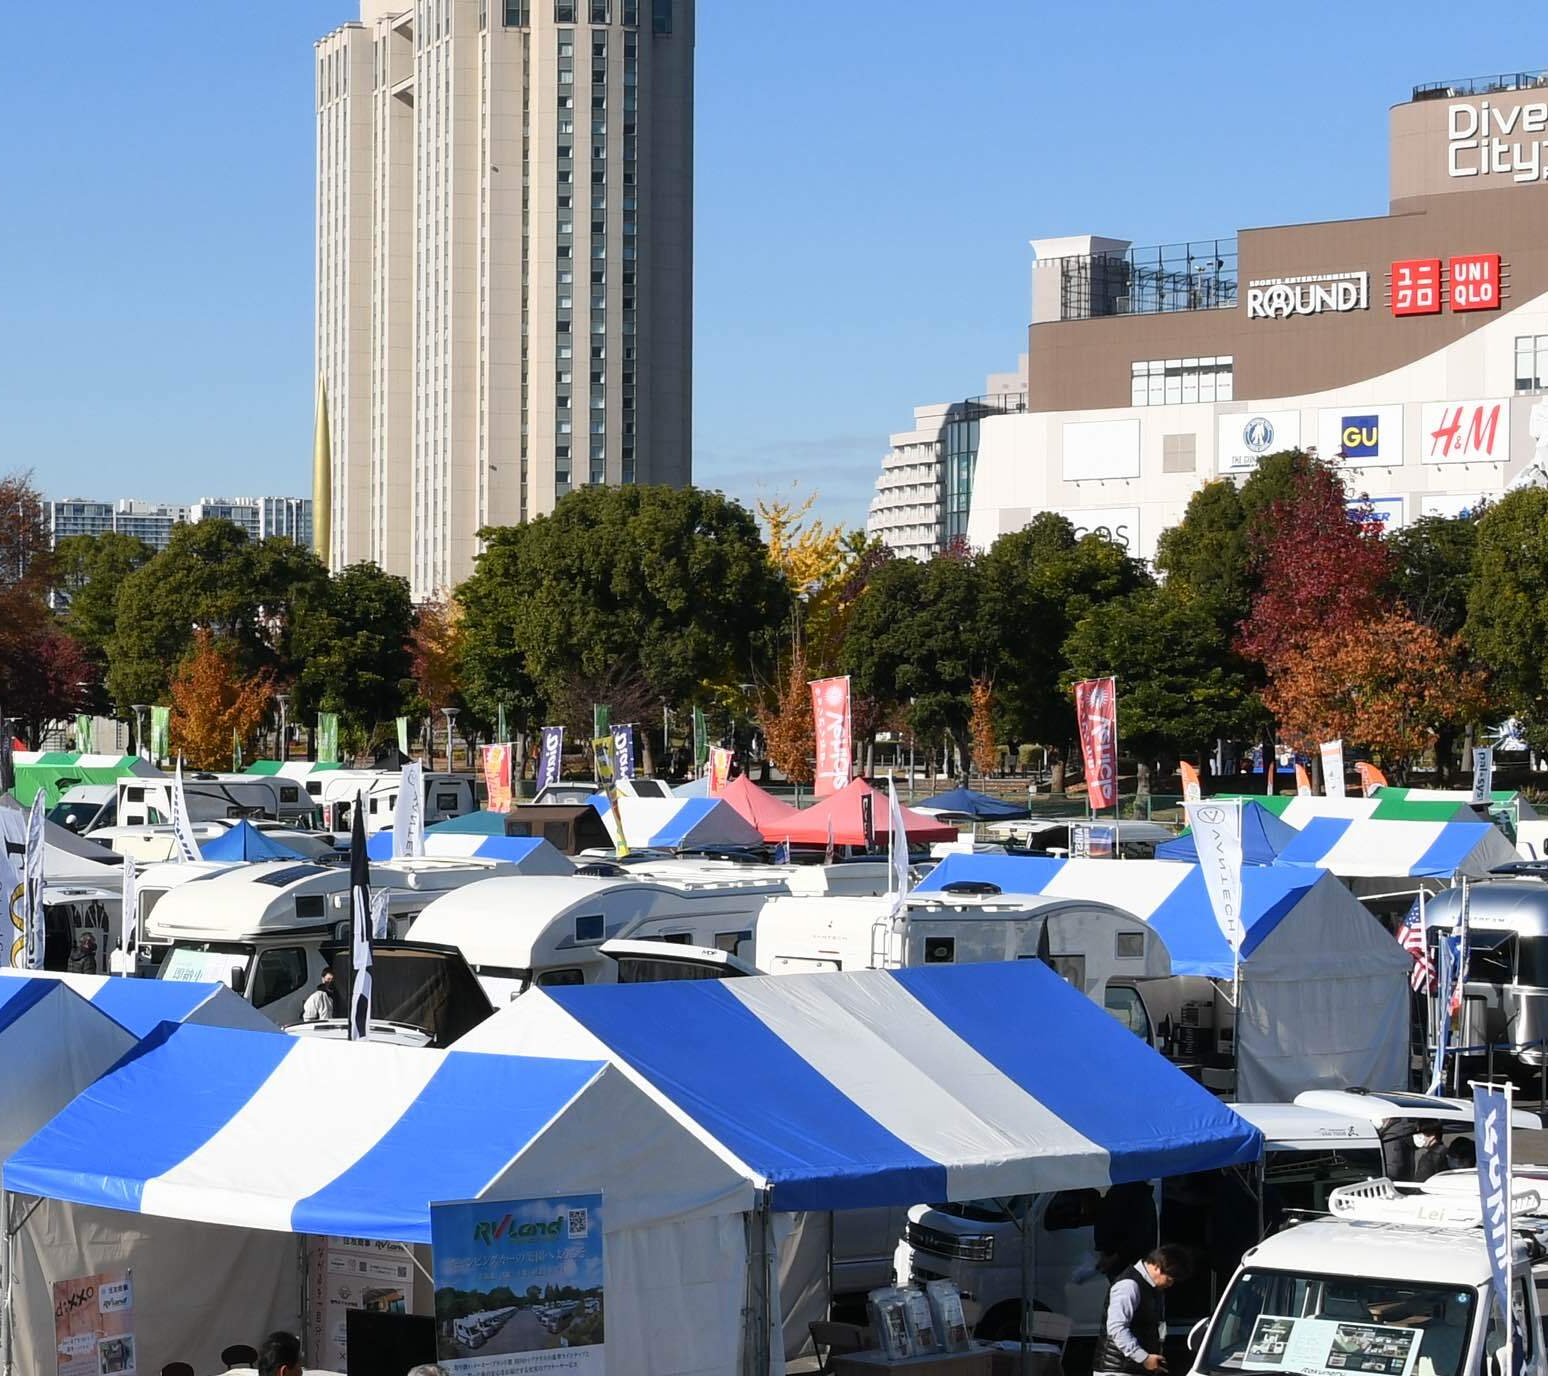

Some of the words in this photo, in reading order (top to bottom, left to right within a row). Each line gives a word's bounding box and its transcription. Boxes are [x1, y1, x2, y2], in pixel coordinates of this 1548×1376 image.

[1448, 137, 1540, 183] City
[1397, 266, 1433, 286] ユニ
[1454, 262, 1490, 281] UNI
[1397, 288, 1433, 308] クロ
[1454, 284, 1492, 306] QLO
[1343, 426, 1378, 447] GU
[1430, 404, 1501, 457] H&M
